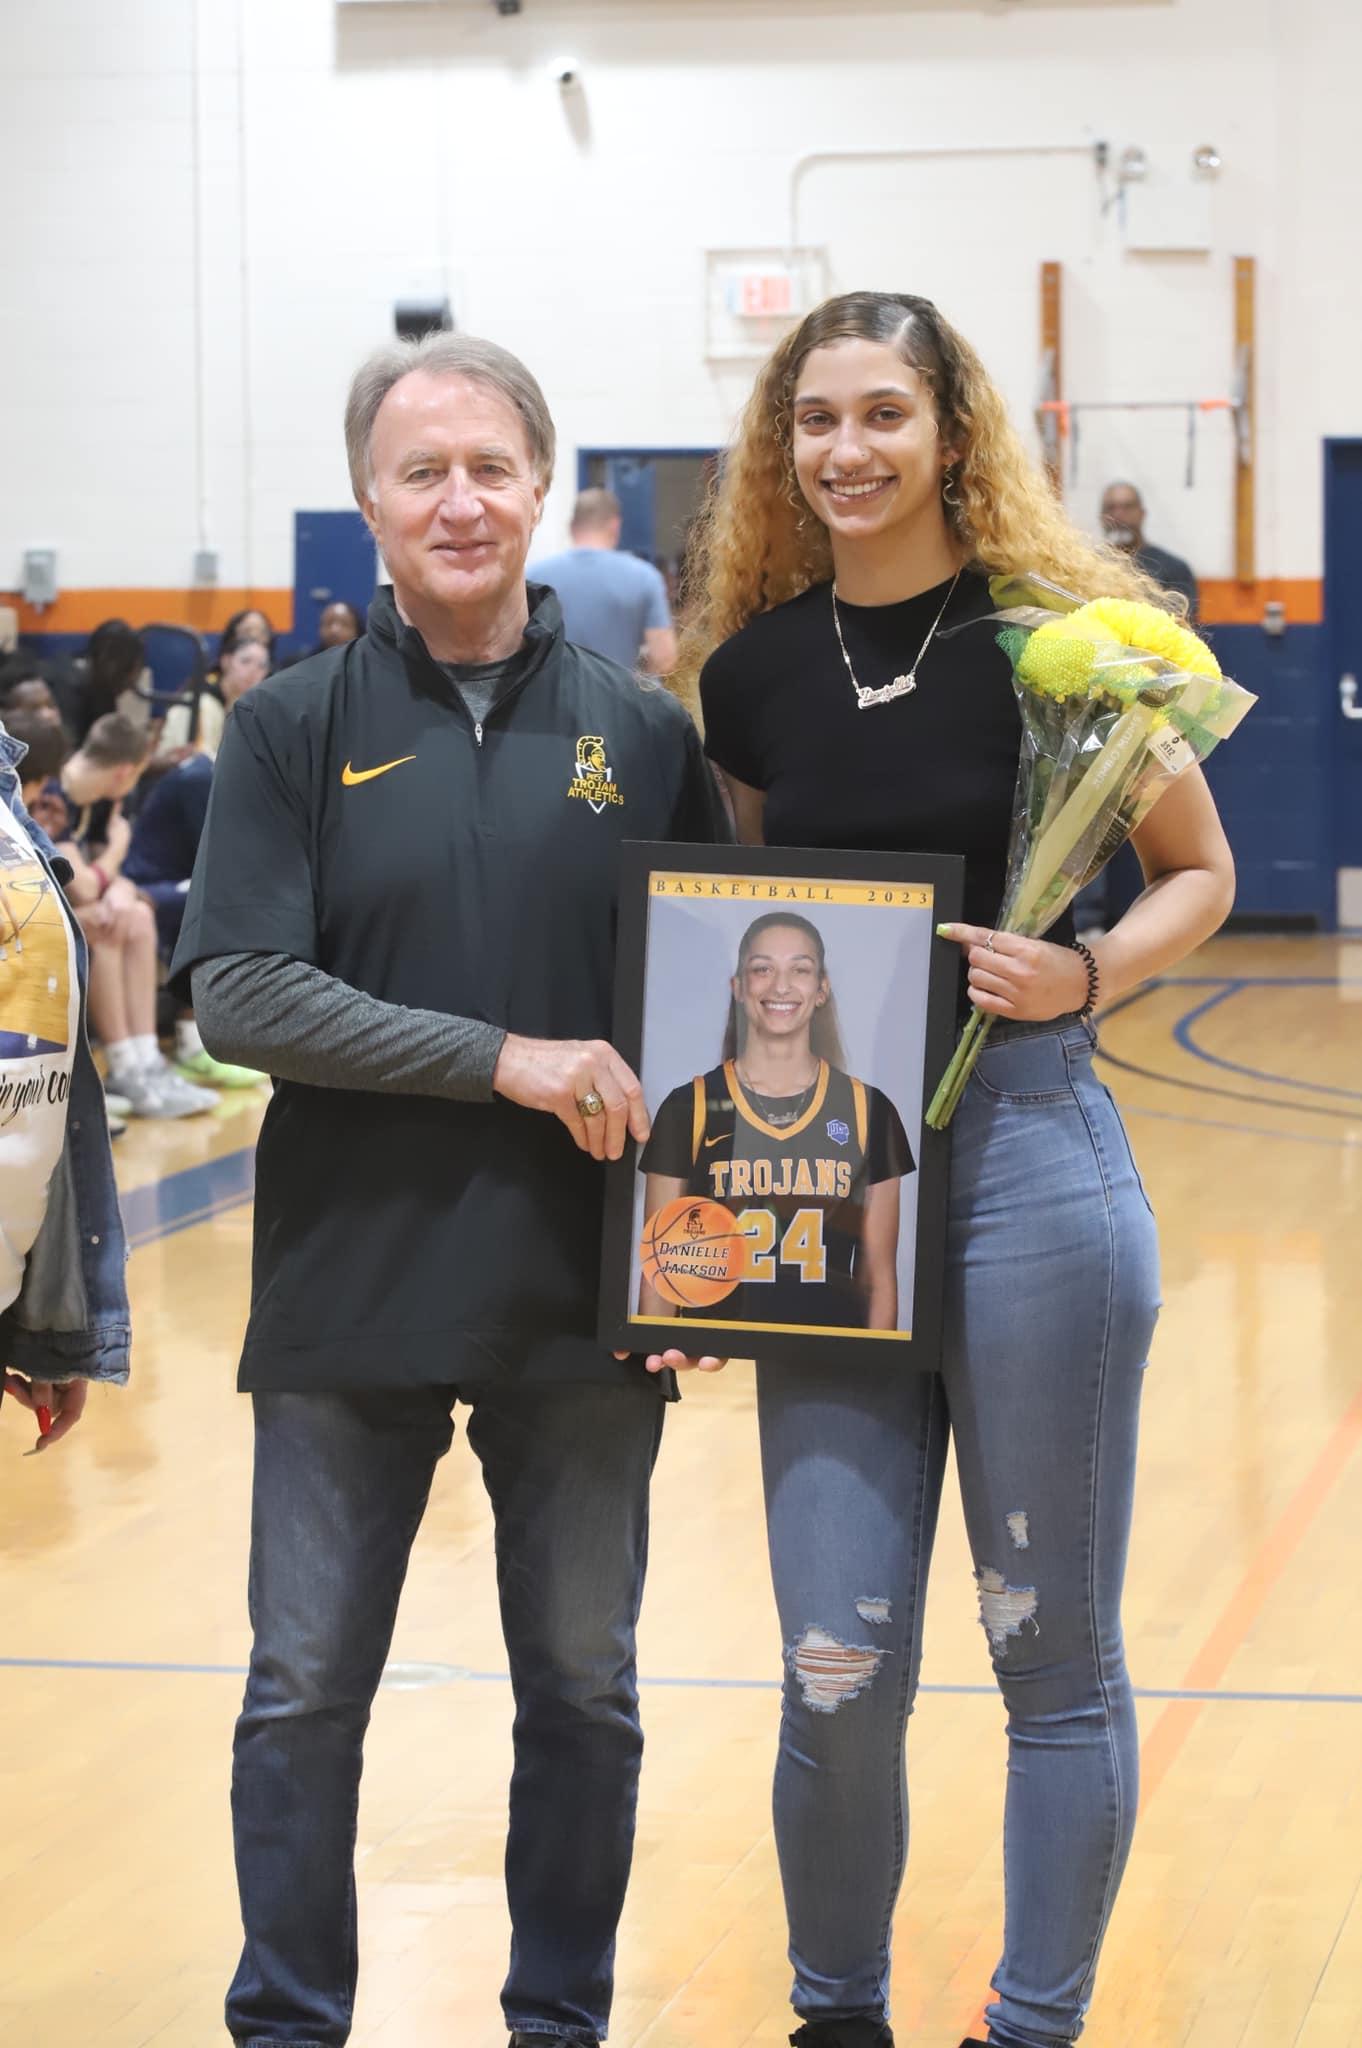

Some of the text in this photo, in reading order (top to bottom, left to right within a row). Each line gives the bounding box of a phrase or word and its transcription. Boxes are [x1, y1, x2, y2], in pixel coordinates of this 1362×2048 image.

[572, 777, 617, 793] TROJAN
[567, 786, 625, 805] ATHLETICS
[656, 880, 928, 905] BASKETBALL 2023
[708, 1159, 851, 1198] TROJANS
[659, 1241, 729, 1259] DANIELLE
[736, 1208, 827, 1284] 24
[659, 1260, 727, 1277] JACKSON
